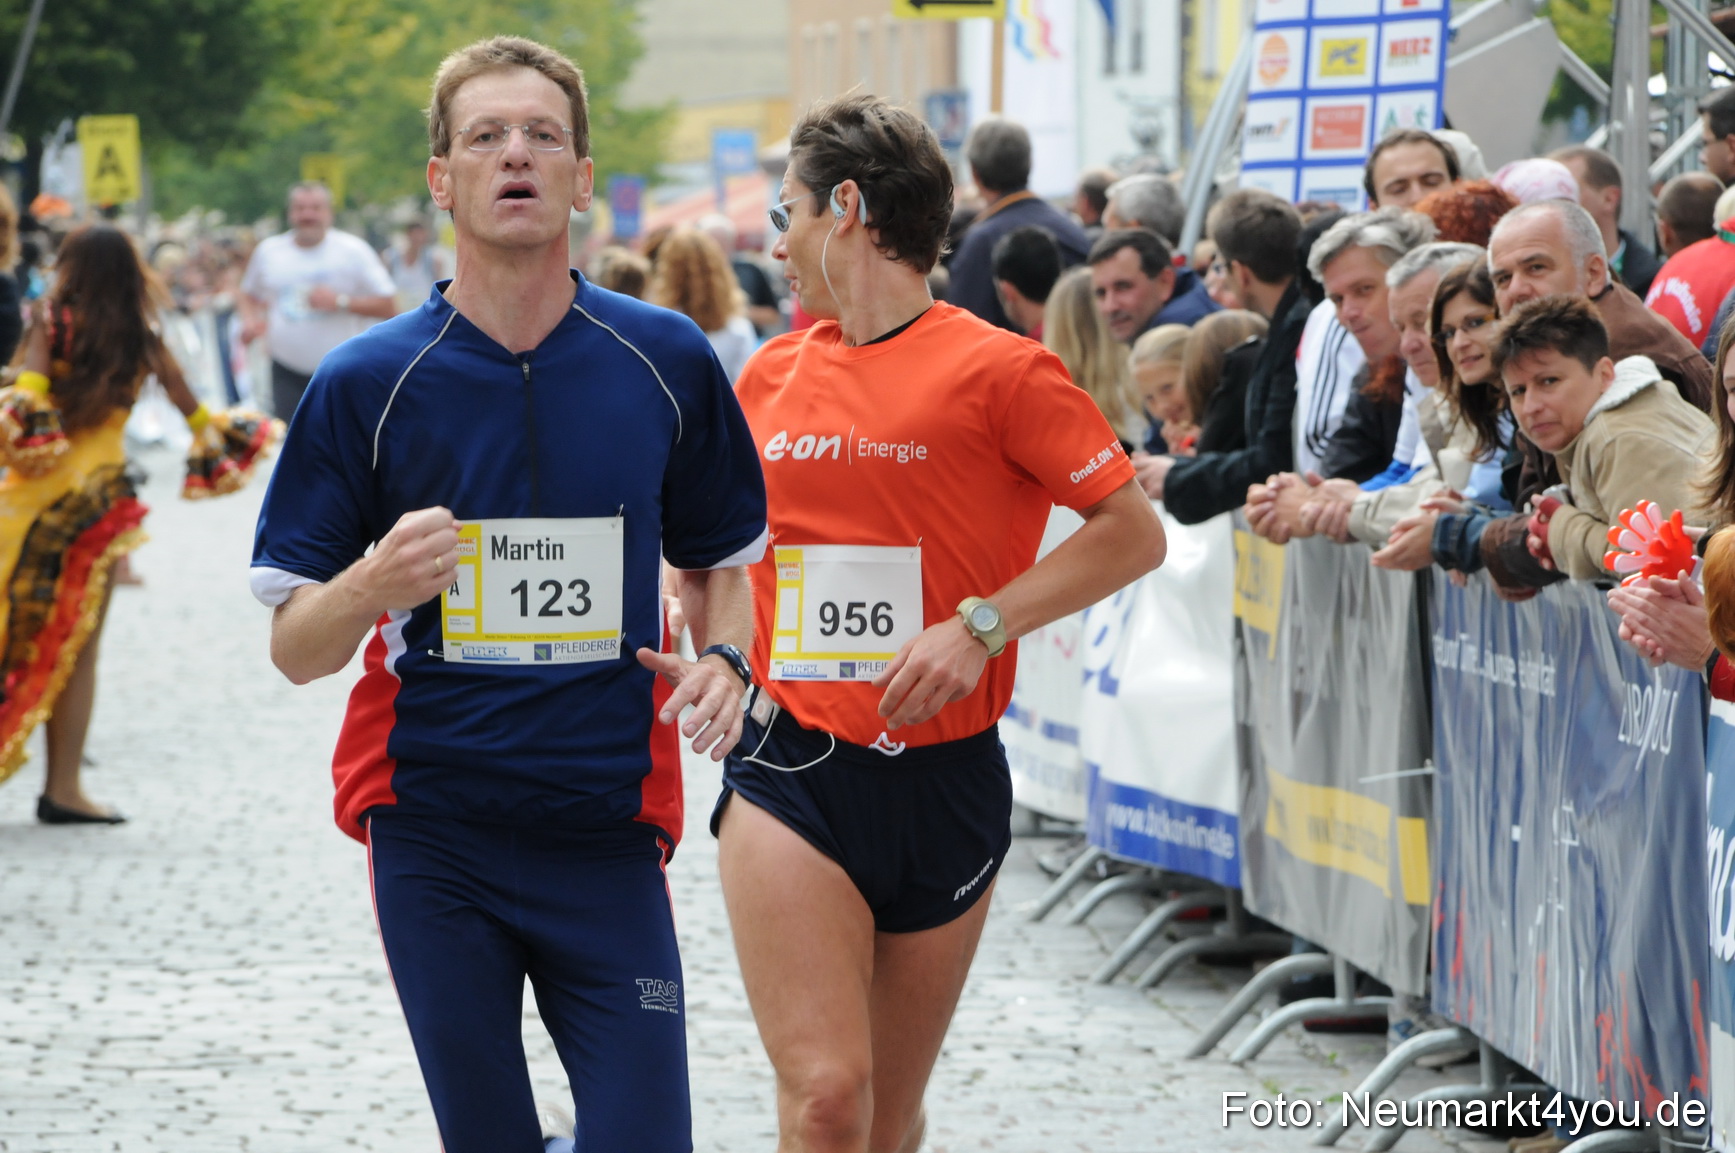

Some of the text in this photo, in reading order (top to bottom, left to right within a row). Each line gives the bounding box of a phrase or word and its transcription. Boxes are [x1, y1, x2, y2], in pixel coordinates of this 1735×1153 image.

[94, 144, 127, 180] A
[857, 437, 928, 464] Energie
[1069, 447, 1114, 484] OneE.ON
[491, 534, 564, 561] Martin
[510, 578, 592, 618] 123
[819, 601, 894, 637] 956
[554, 639, 618, 654] PFLEIDERER
